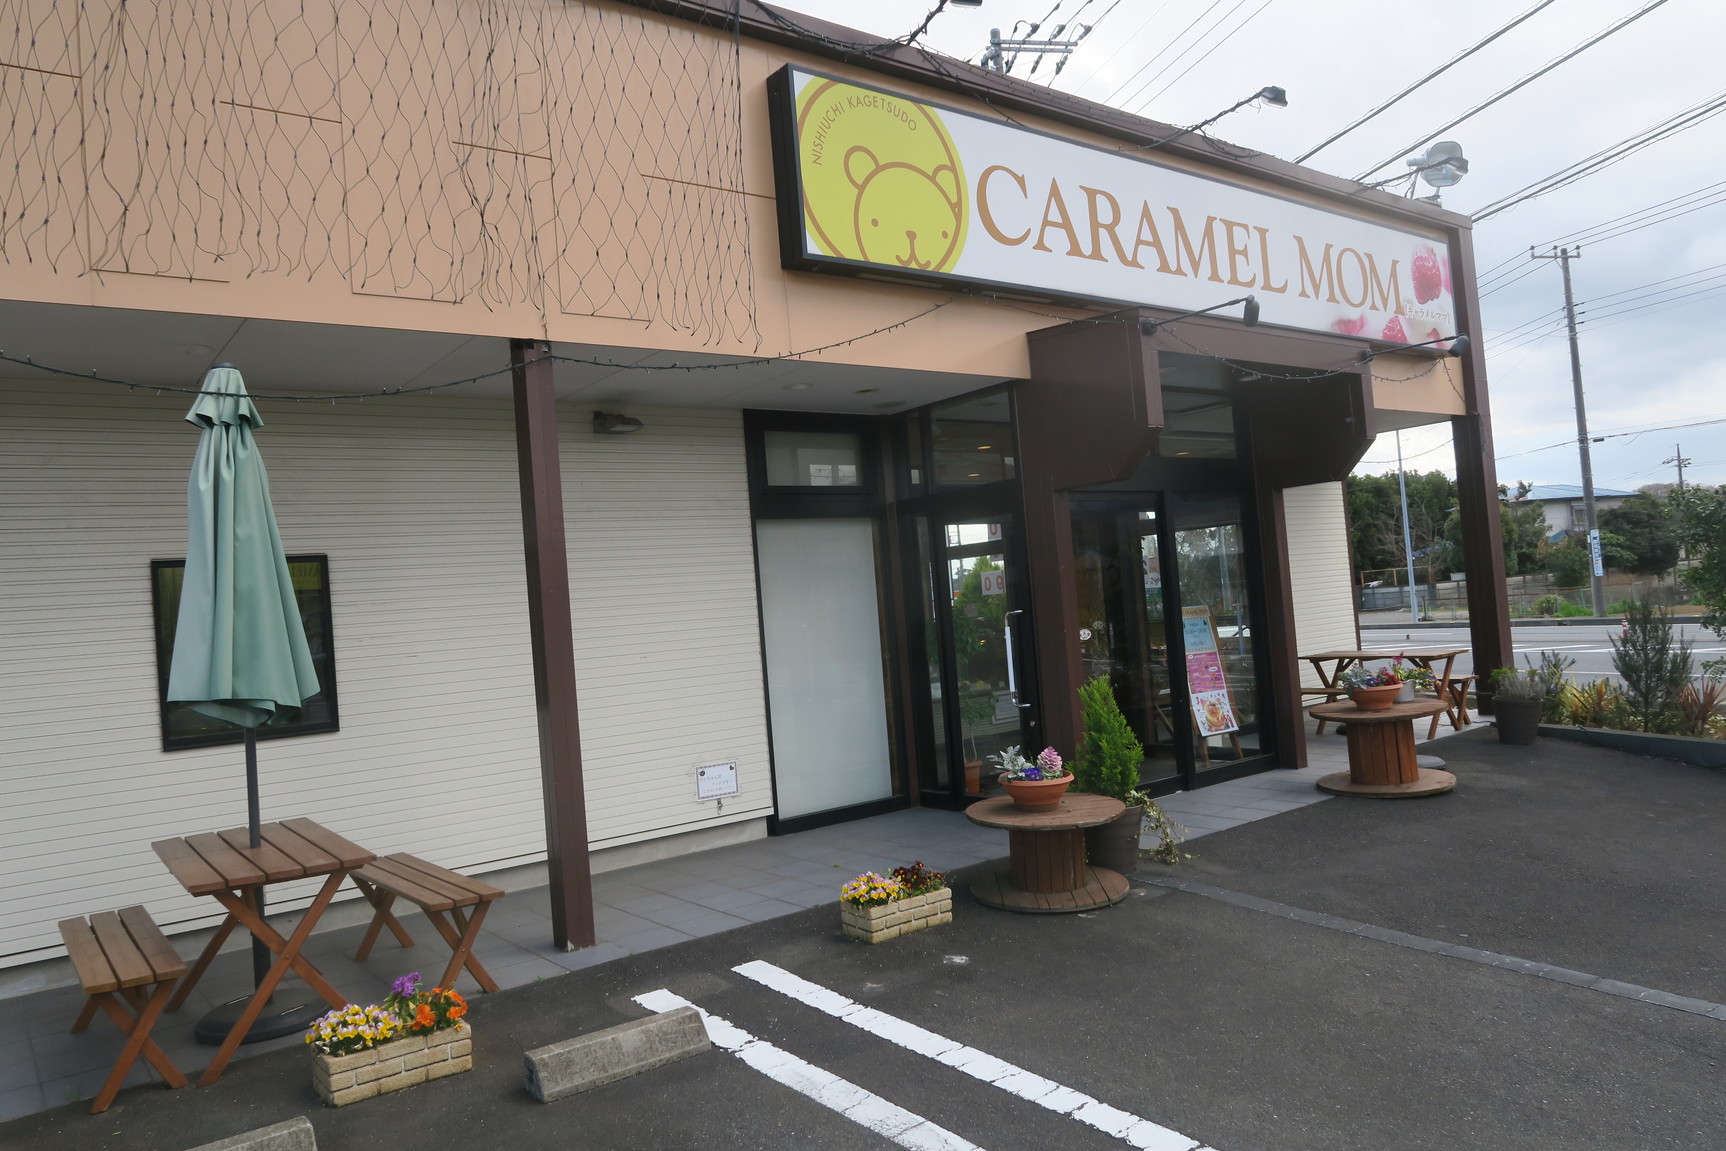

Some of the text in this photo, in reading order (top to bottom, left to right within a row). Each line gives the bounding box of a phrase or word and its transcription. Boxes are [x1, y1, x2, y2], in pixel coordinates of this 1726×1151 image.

[812, 95, 917, 166] NISHIUCHI KAGETSUDO
[976, 165, 1405, 316] CARAMEL MOM
